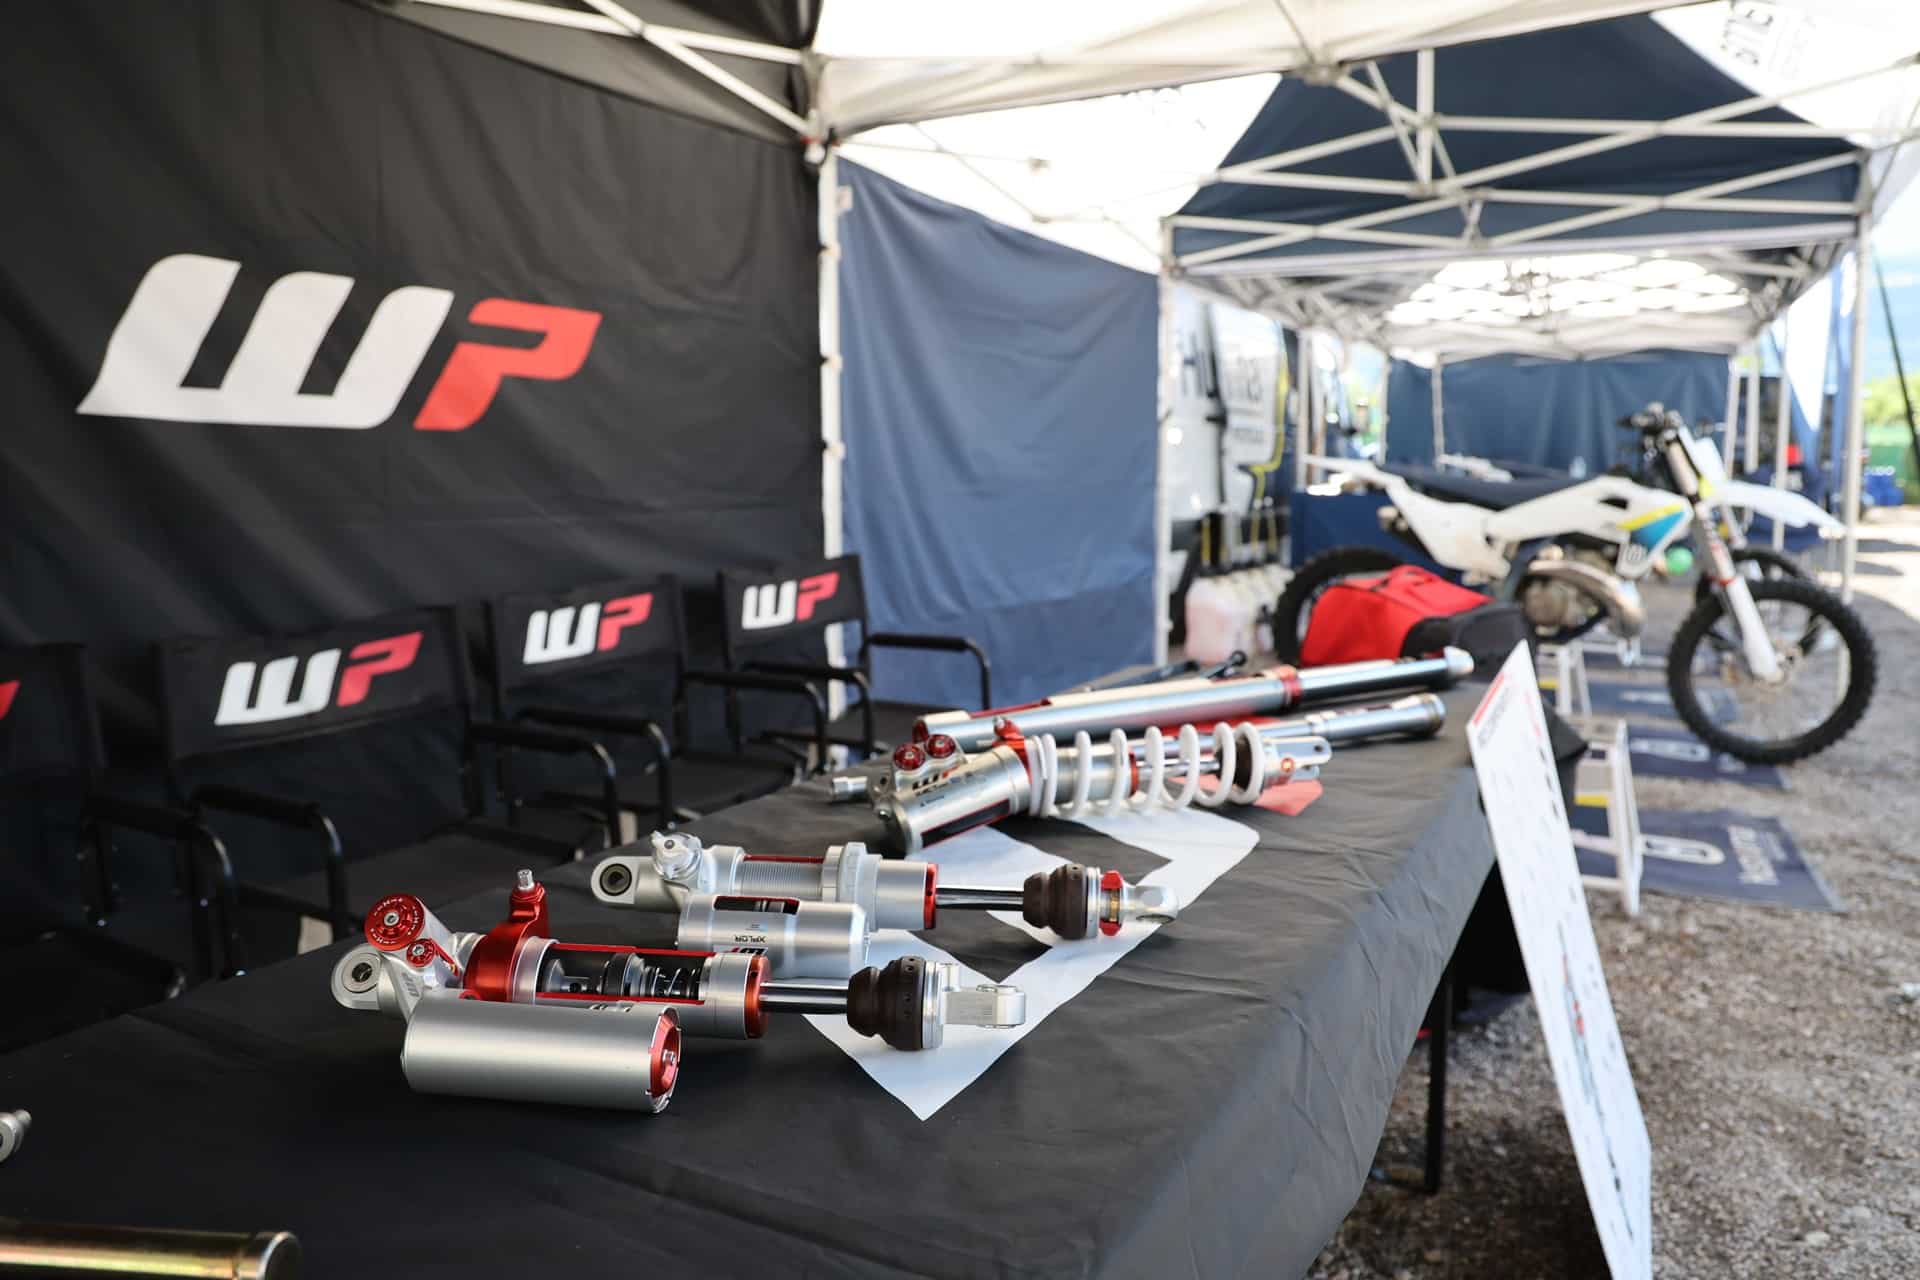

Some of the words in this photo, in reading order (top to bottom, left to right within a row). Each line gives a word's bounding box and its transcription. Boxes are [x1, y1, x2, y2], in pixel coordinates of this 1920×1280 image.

[77, 253, 604, 432] WP
[523, 592, 654, 665] WP
[742, 571, 840, 630] WP
[214, 631, 423, 727] WP
[734, 935, 767, 944] XPLOR
